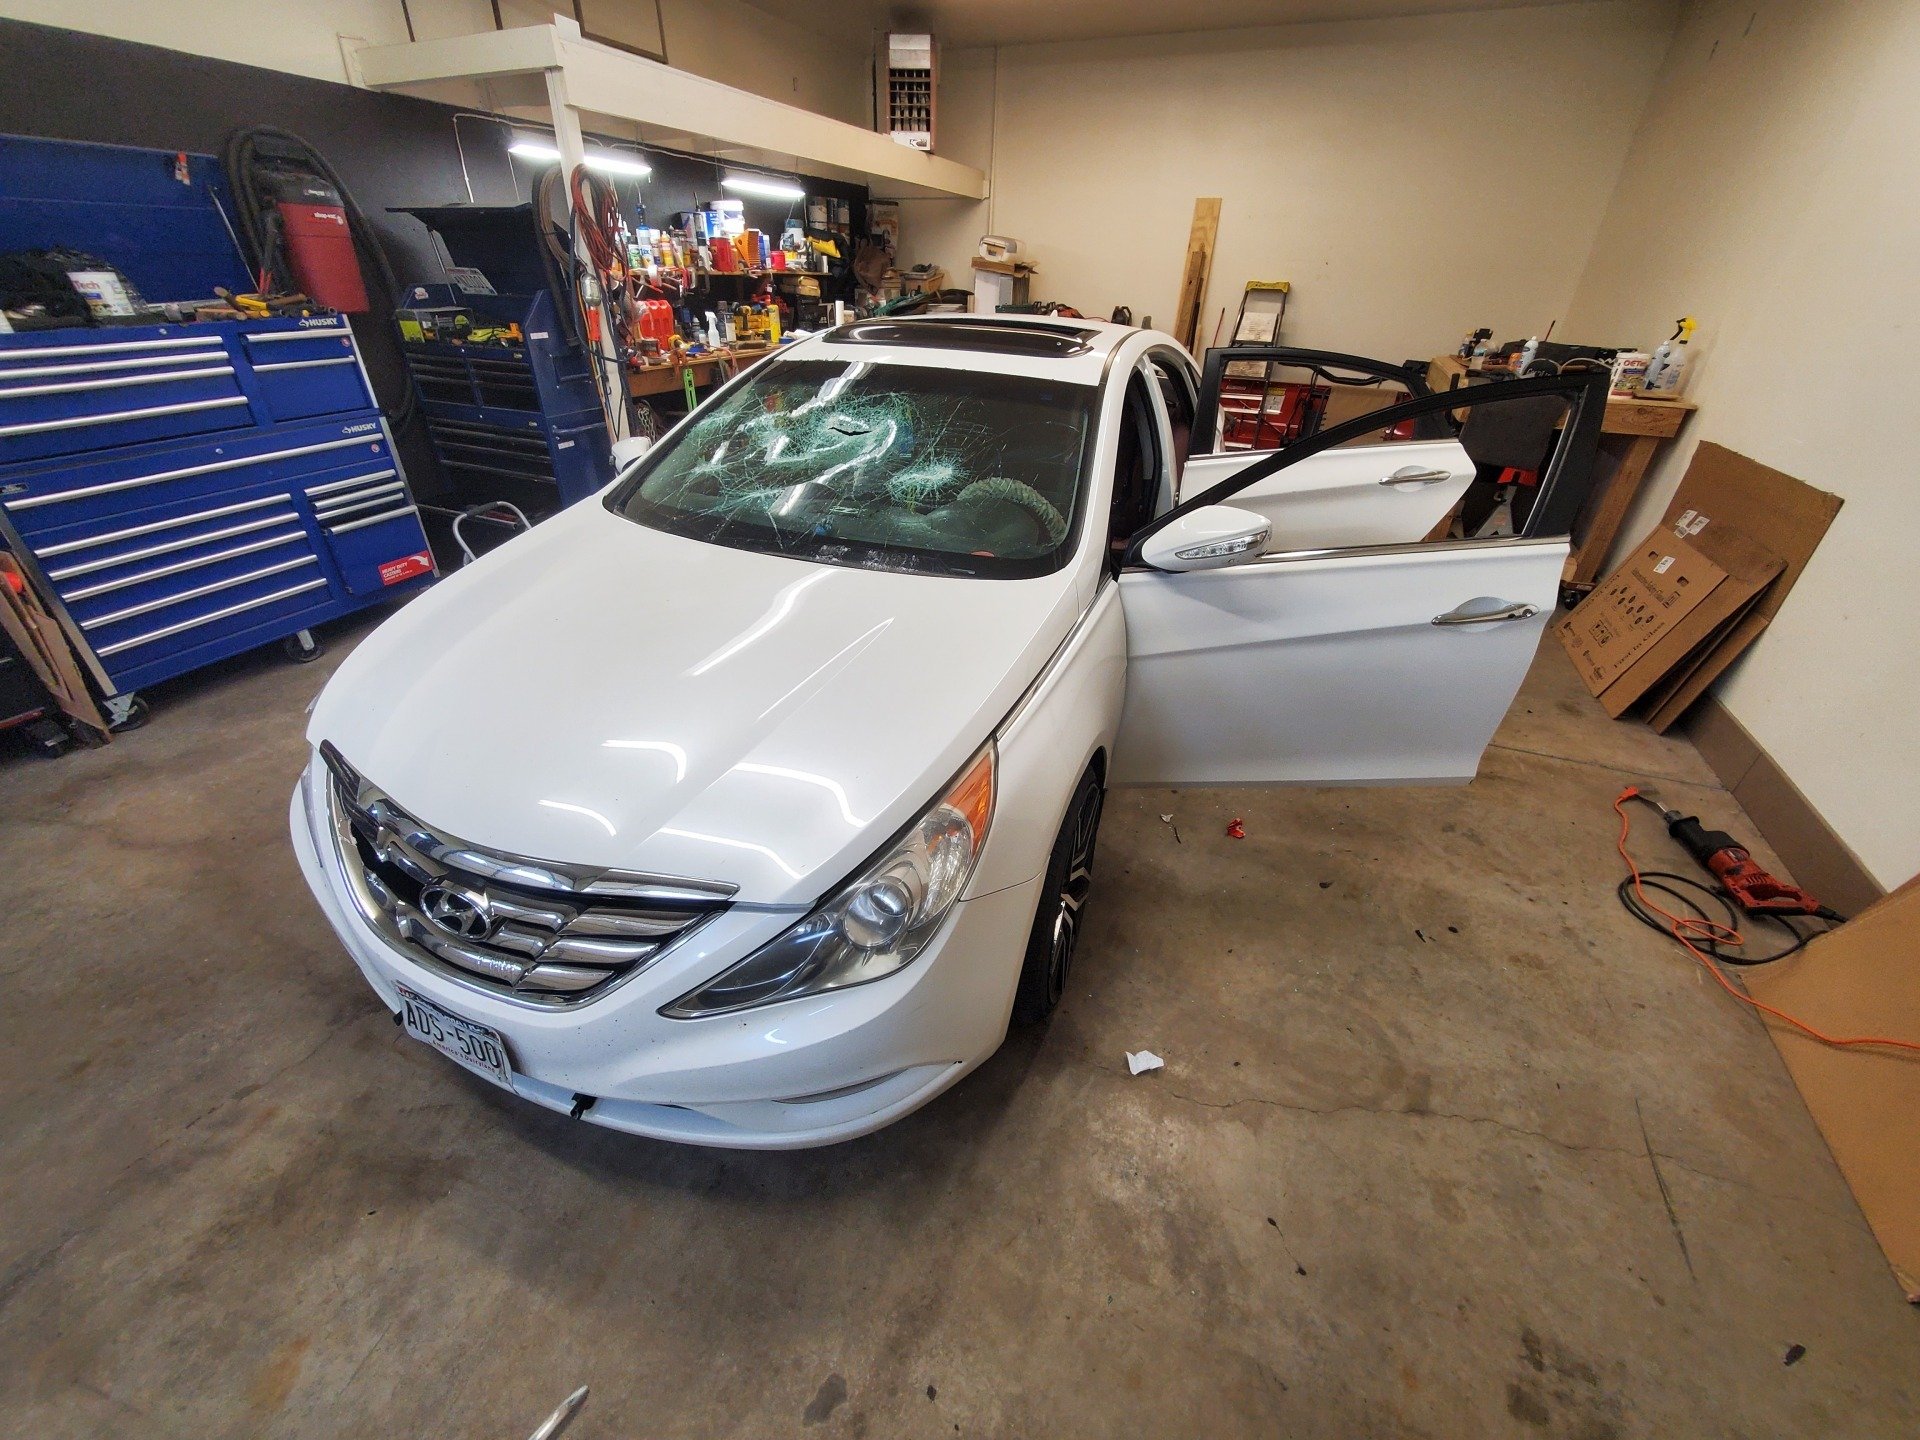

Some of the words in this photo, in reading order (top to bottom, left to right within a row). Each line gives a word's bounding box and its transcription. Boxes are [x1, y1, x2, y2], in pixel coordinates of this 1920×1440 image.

[309, 317, 338, 327] HUSKY
[350, 422, 376, 433] HUSKY
[1613, 650, 1632, 669] First
[1642, 620, 1665, 642] Glass
[431, 1039, 464, 1059] America's
[464, 1054, 496, 1074] Dairyland
